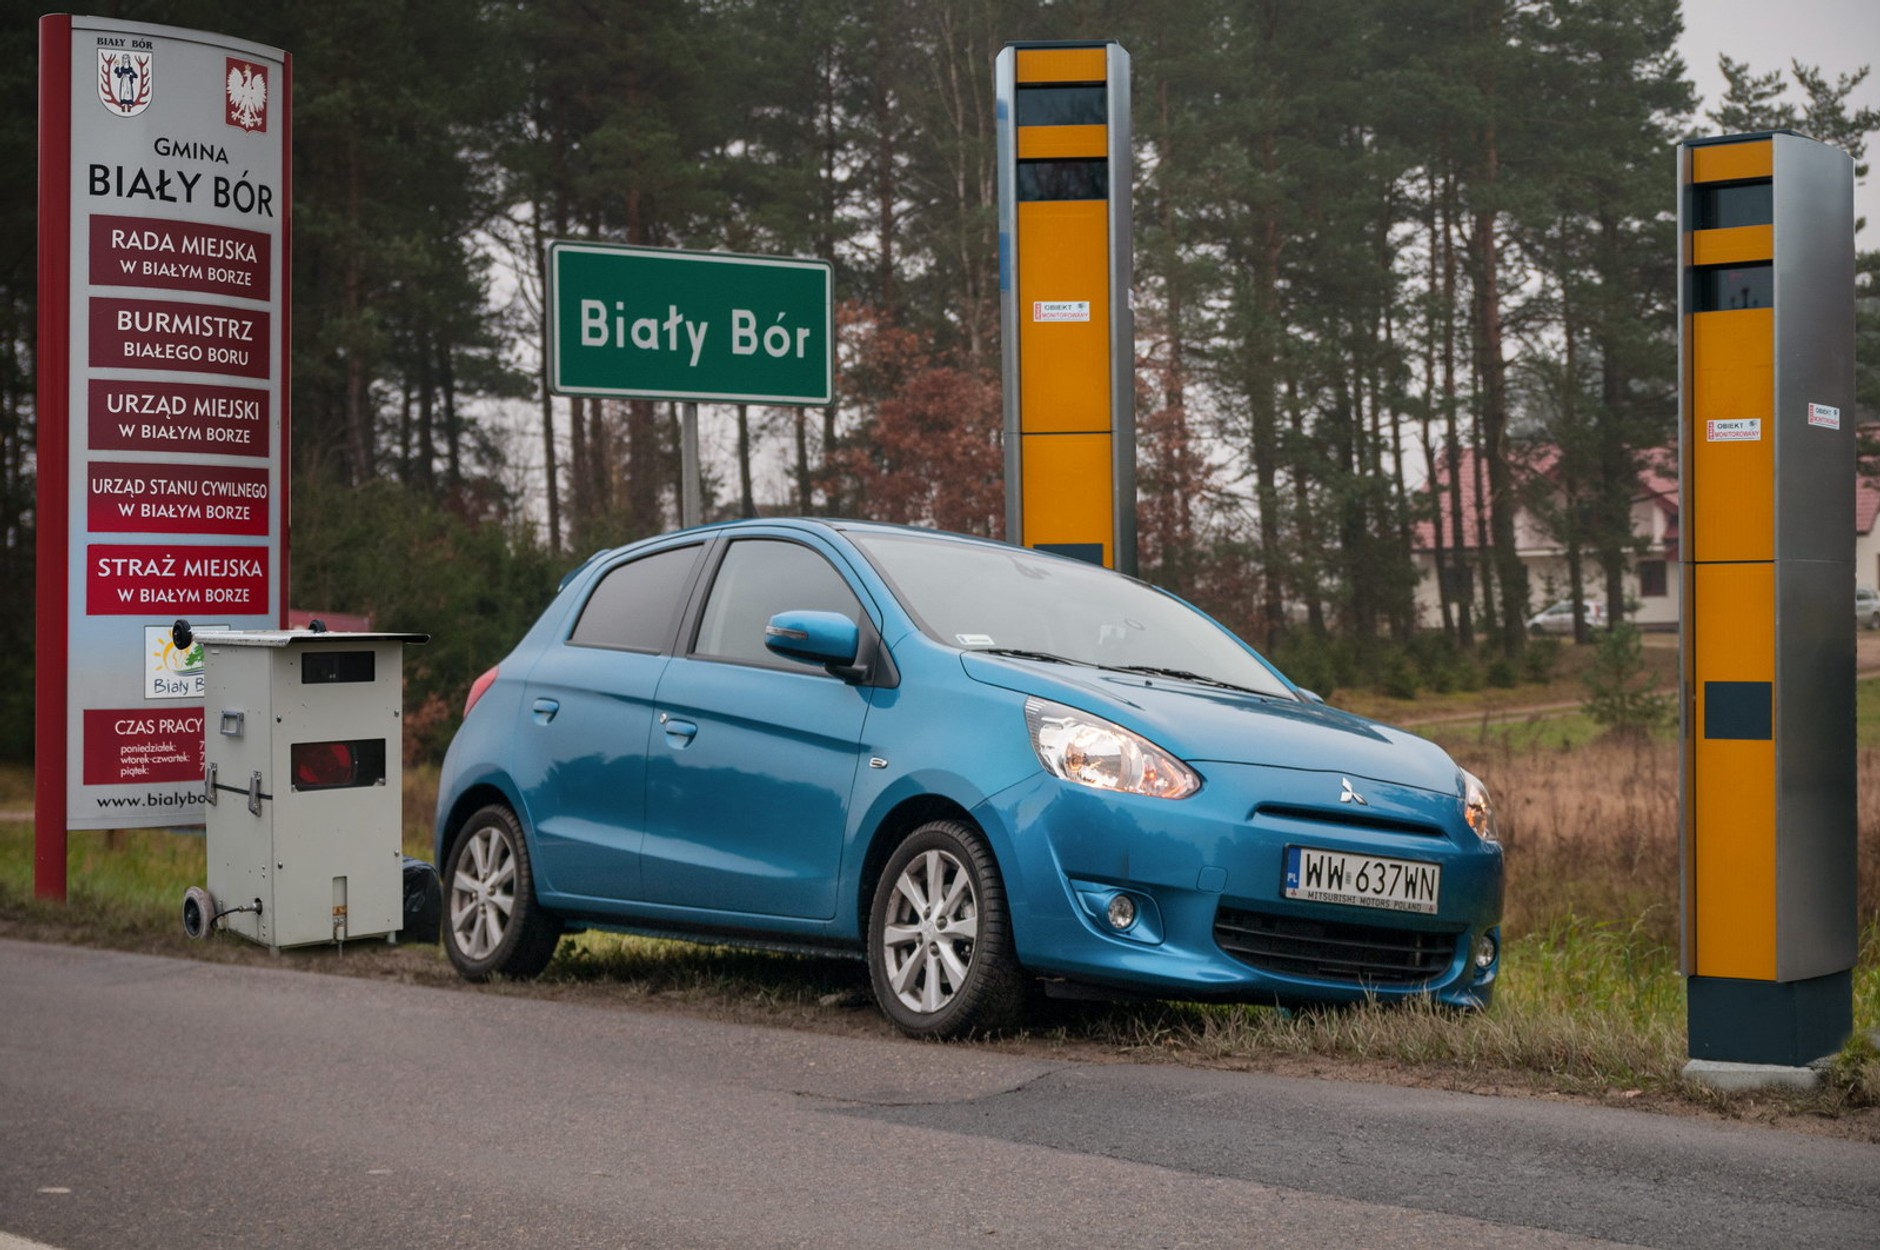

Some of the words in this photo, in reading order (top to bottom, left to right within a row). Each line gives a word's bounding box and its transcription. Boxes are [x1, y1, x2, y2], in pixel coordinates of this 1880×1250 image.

[97, 37, 126, 47] BIAŁY
[132, 38, 153, 49] BÓR
[154, 138, 229, 164] GMINA
[89, 164, 202, 203] BIAŁY
[214, 170, 273, 217] BÓR
[112, 230, 175, 252] RADA
[181, 235, 258, 263] MIEJSKA
[120, 260, 137, 273] W
[143, 261, 203, 280] BIAŁYM
[207, 267, 252, 286] BORZE
[117, 311, 253, 341] BURMISTRZ
[581, 299, 708, 367] Biały
[732, 309, 810, 358] Bór
[124, 342, 202, 361] BIAŁEGO
[207, 348, 249, 366] BORU
[107, 394, 187, 419] URZĄD
[193, 398, 259, 420] MIEJSKI
[119, 424, 135, 438] W
[141, 425, 202, 441] BIAŁYM
[206, 428, 251, 444] BORZE
[92, 479, 145, 498] URZĄD
[150, 479, 198, 496] STANU
[201, 481, 267, 499] CYWILNEGO
[118, 503, 135, 517] W
[141, 504, 202, 518] BIAŁYM
[206, 505, 250, 520] BORZE
[97, 554, 176, 577] STRAŻ
[183, 559, 263, 578] MIEJSKA
[118, 588, 134, 602] W
[140, 589, 201, 602] BIAŁYM
[205, 589, 250, 602] BORZE
[114, 719, 156, 735] CZAS
[159, 718, 204, 734] PRACY
[97, 791, 206, 809] www.bialybo
[1287, 872, 1298, 883] PL
[1306, 853, 1345, 891] WW
[1355, 860, 1435, 902] 637WN
[1307, 890, 1356, 904] MITSUBISHI
[1360, 896, 1390, 909] MOTORS
[1394, 901, 1422, 912] POLAND
